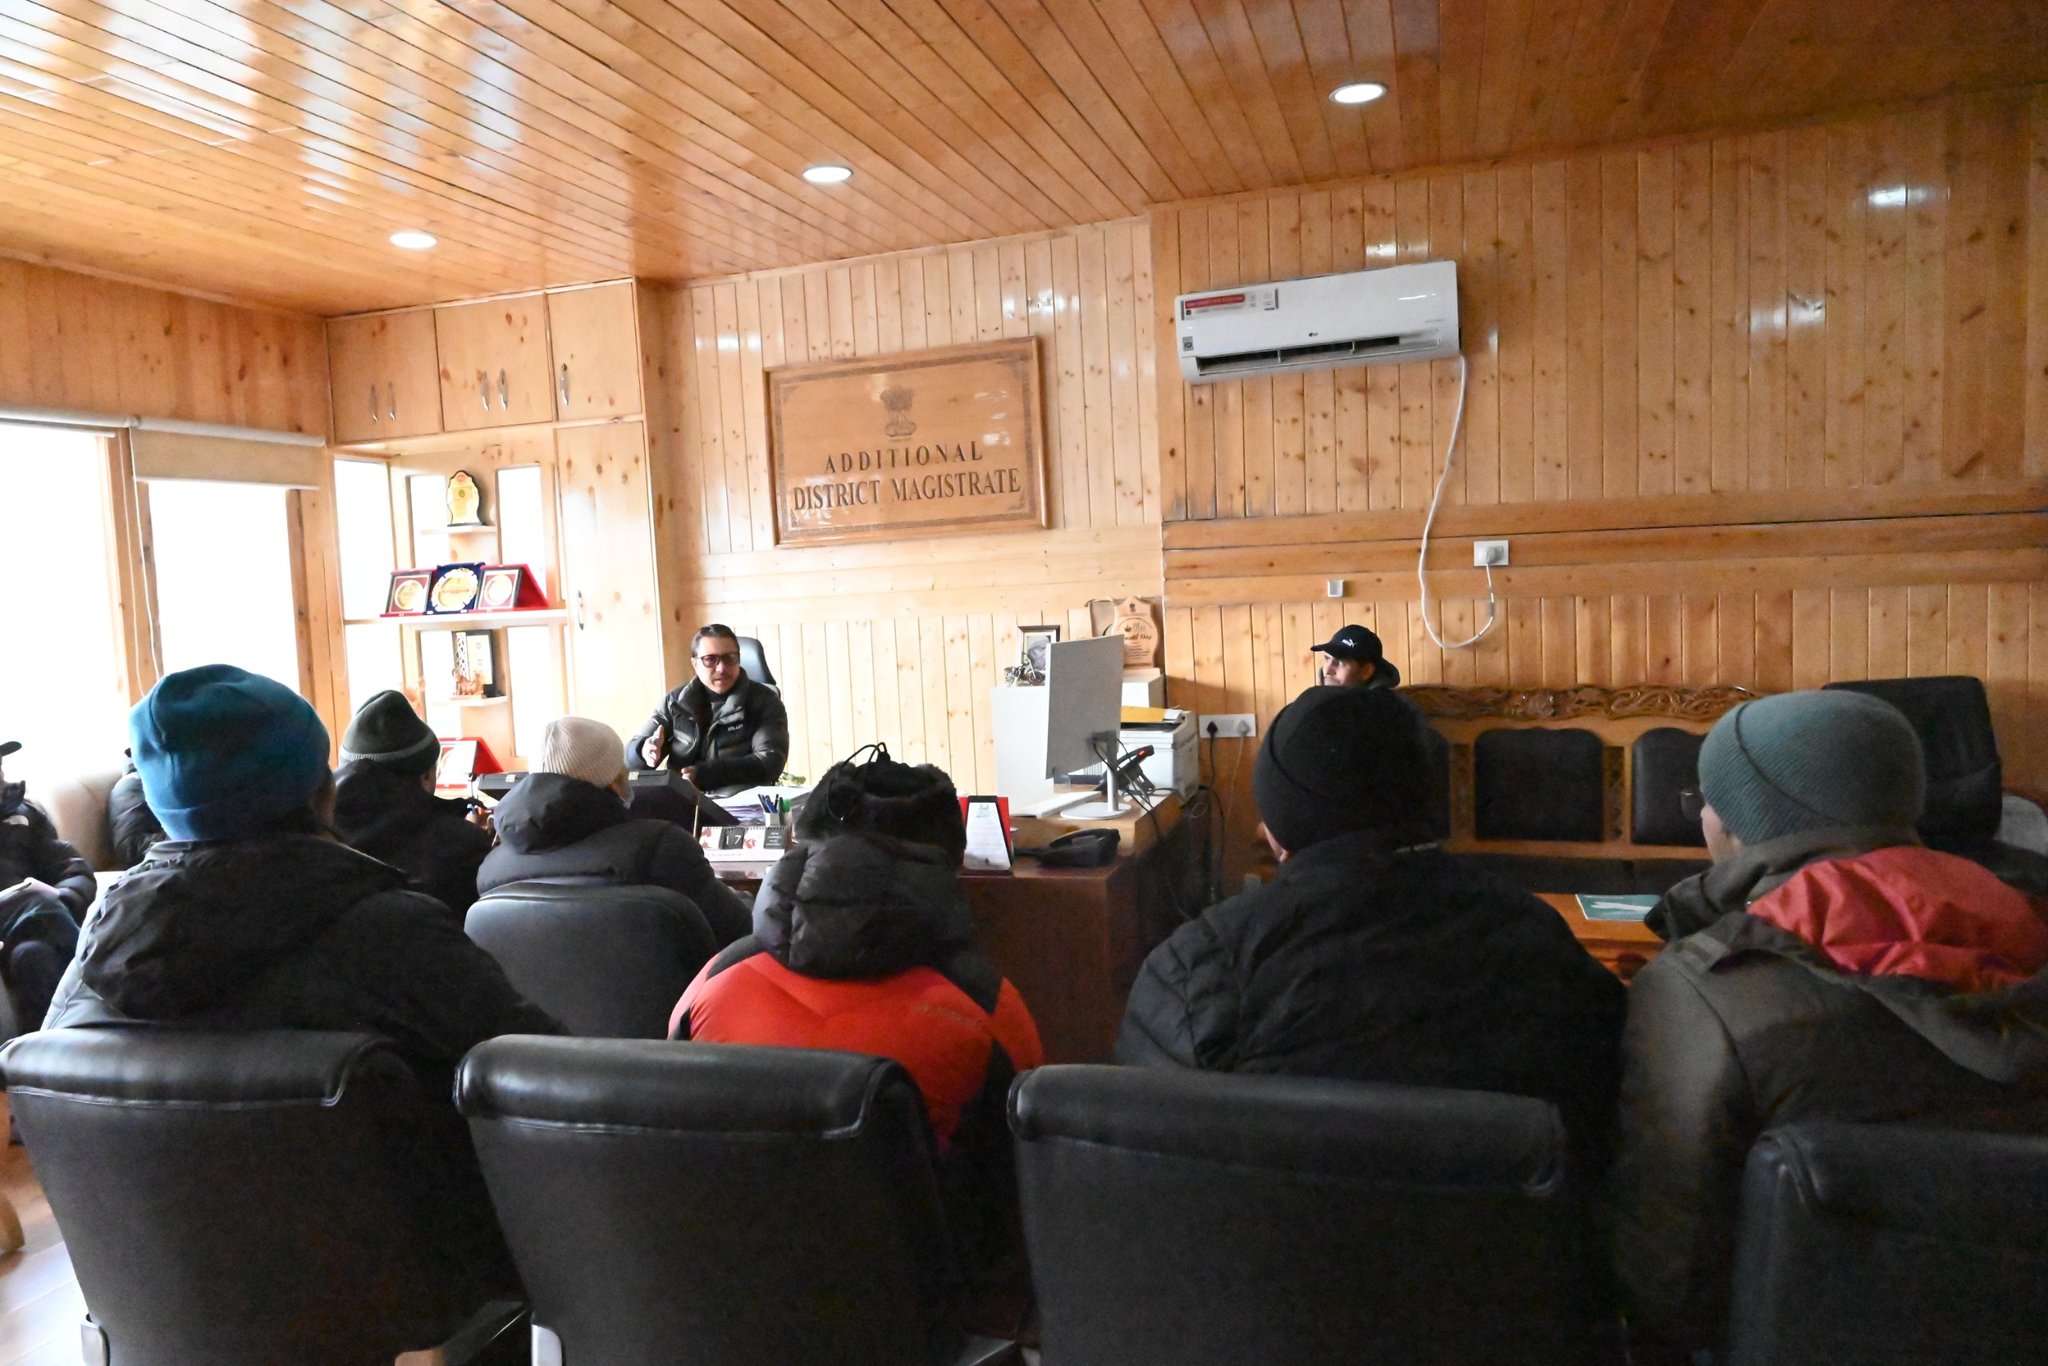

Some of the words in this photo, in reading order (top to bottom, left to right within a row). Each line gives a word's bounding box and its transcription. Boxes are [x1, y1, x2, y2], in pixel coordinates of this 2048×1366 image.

[825, 440, 983, 473] ADDITIONAL
[793, 480, 880, 511] DISTRICT
[891, 468, 1021, 502] MAGISTRATE
